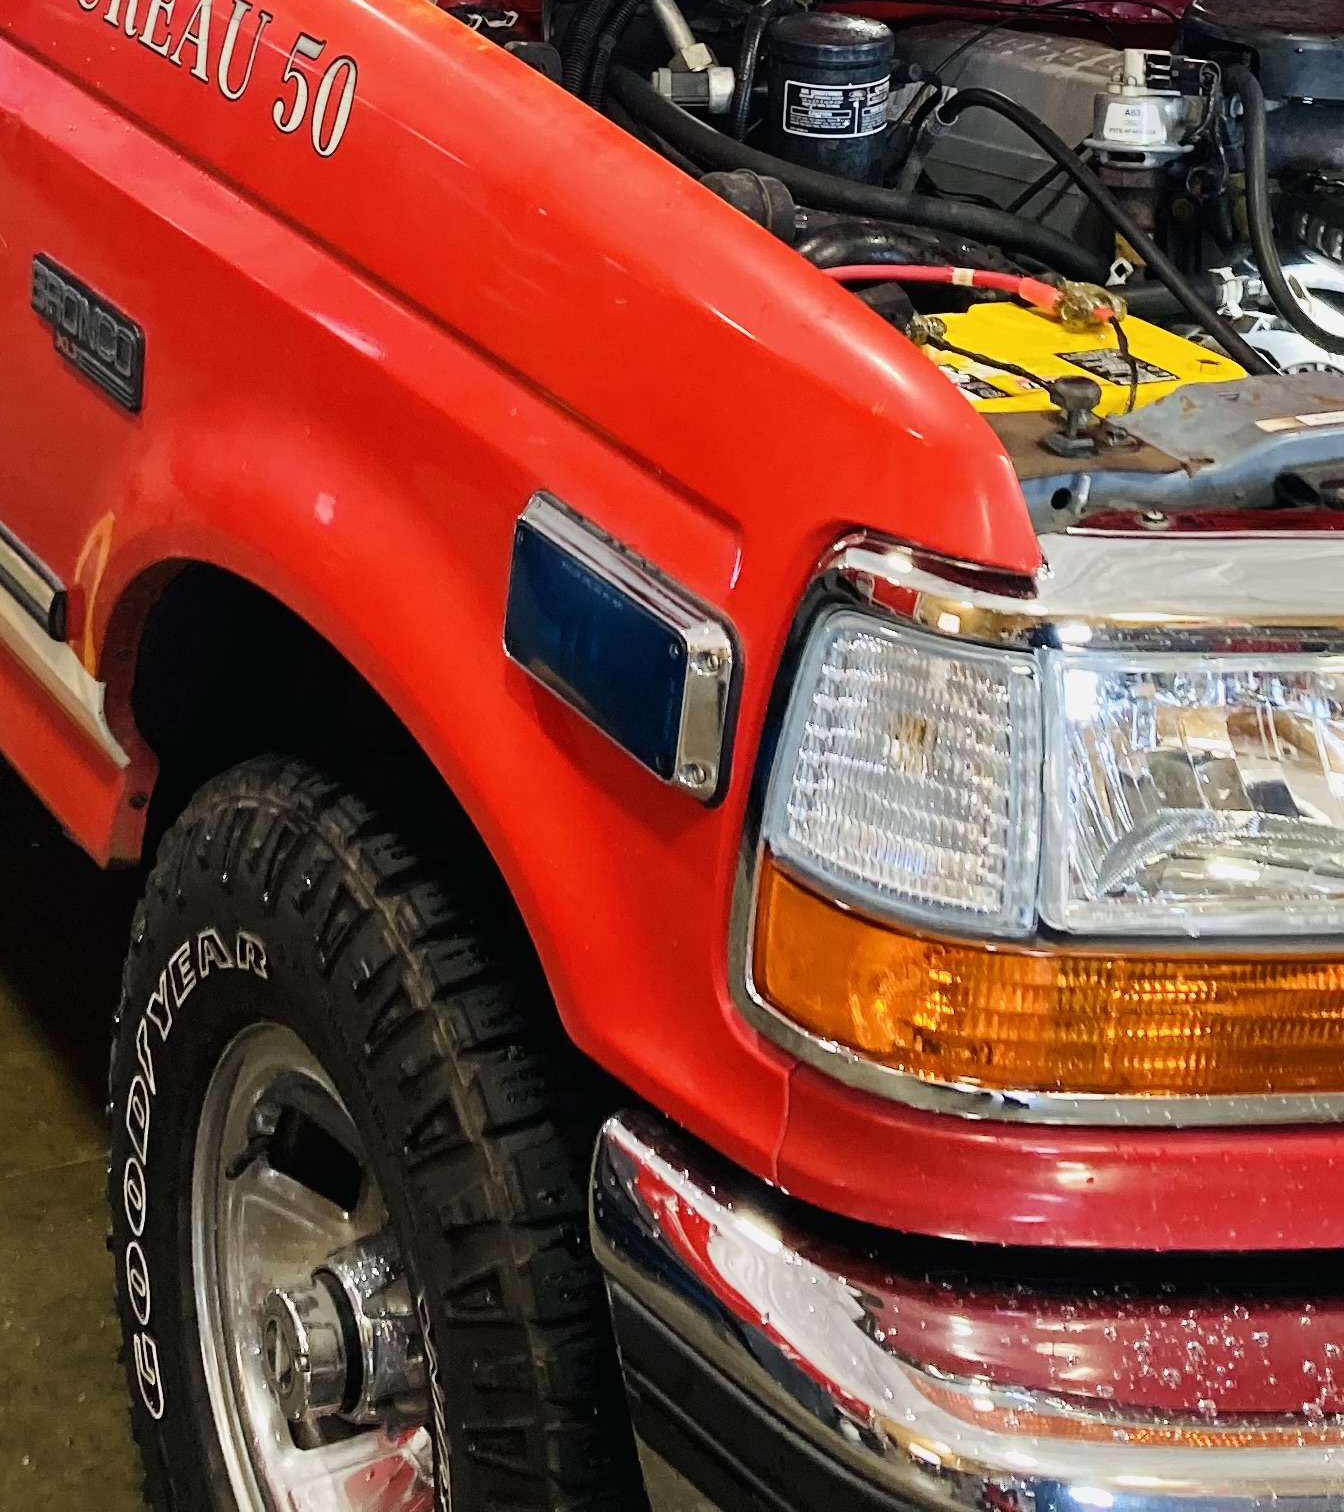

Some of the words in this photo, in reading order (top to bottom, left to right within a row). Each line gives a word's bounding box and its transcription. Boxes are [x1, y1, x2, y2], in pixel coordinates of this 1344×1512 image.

[272, 31, 358, 159] 50
[32, 259, 134, 377] BRONCO
[123, 927, 269, 1420] GOODYEAR
